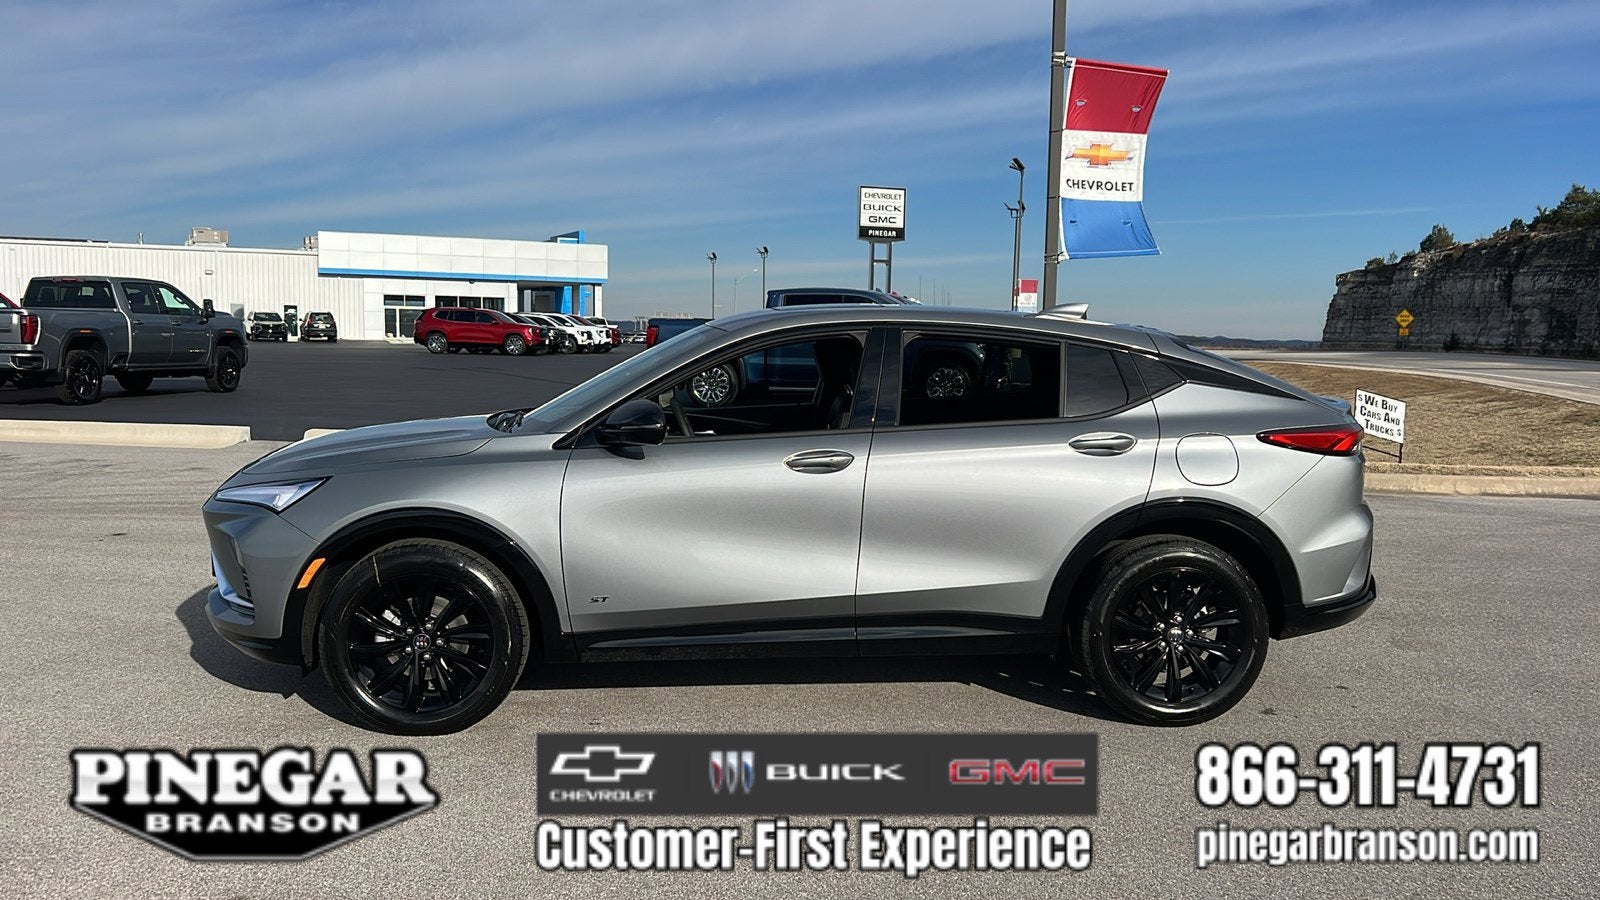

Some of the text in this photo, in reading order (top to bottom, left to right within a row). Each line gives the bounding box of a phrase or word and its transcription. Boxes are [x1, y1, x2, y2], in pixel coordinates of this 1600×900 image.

[1066, 178, 1134, 192] CHEVROLET
[864, 192, 902, 200] CHEVROLET
[863, 203, 902, 212] BUICK
[868, 215, 897, 224] GMC
[868, 229, 897, 237] PINEGAR
